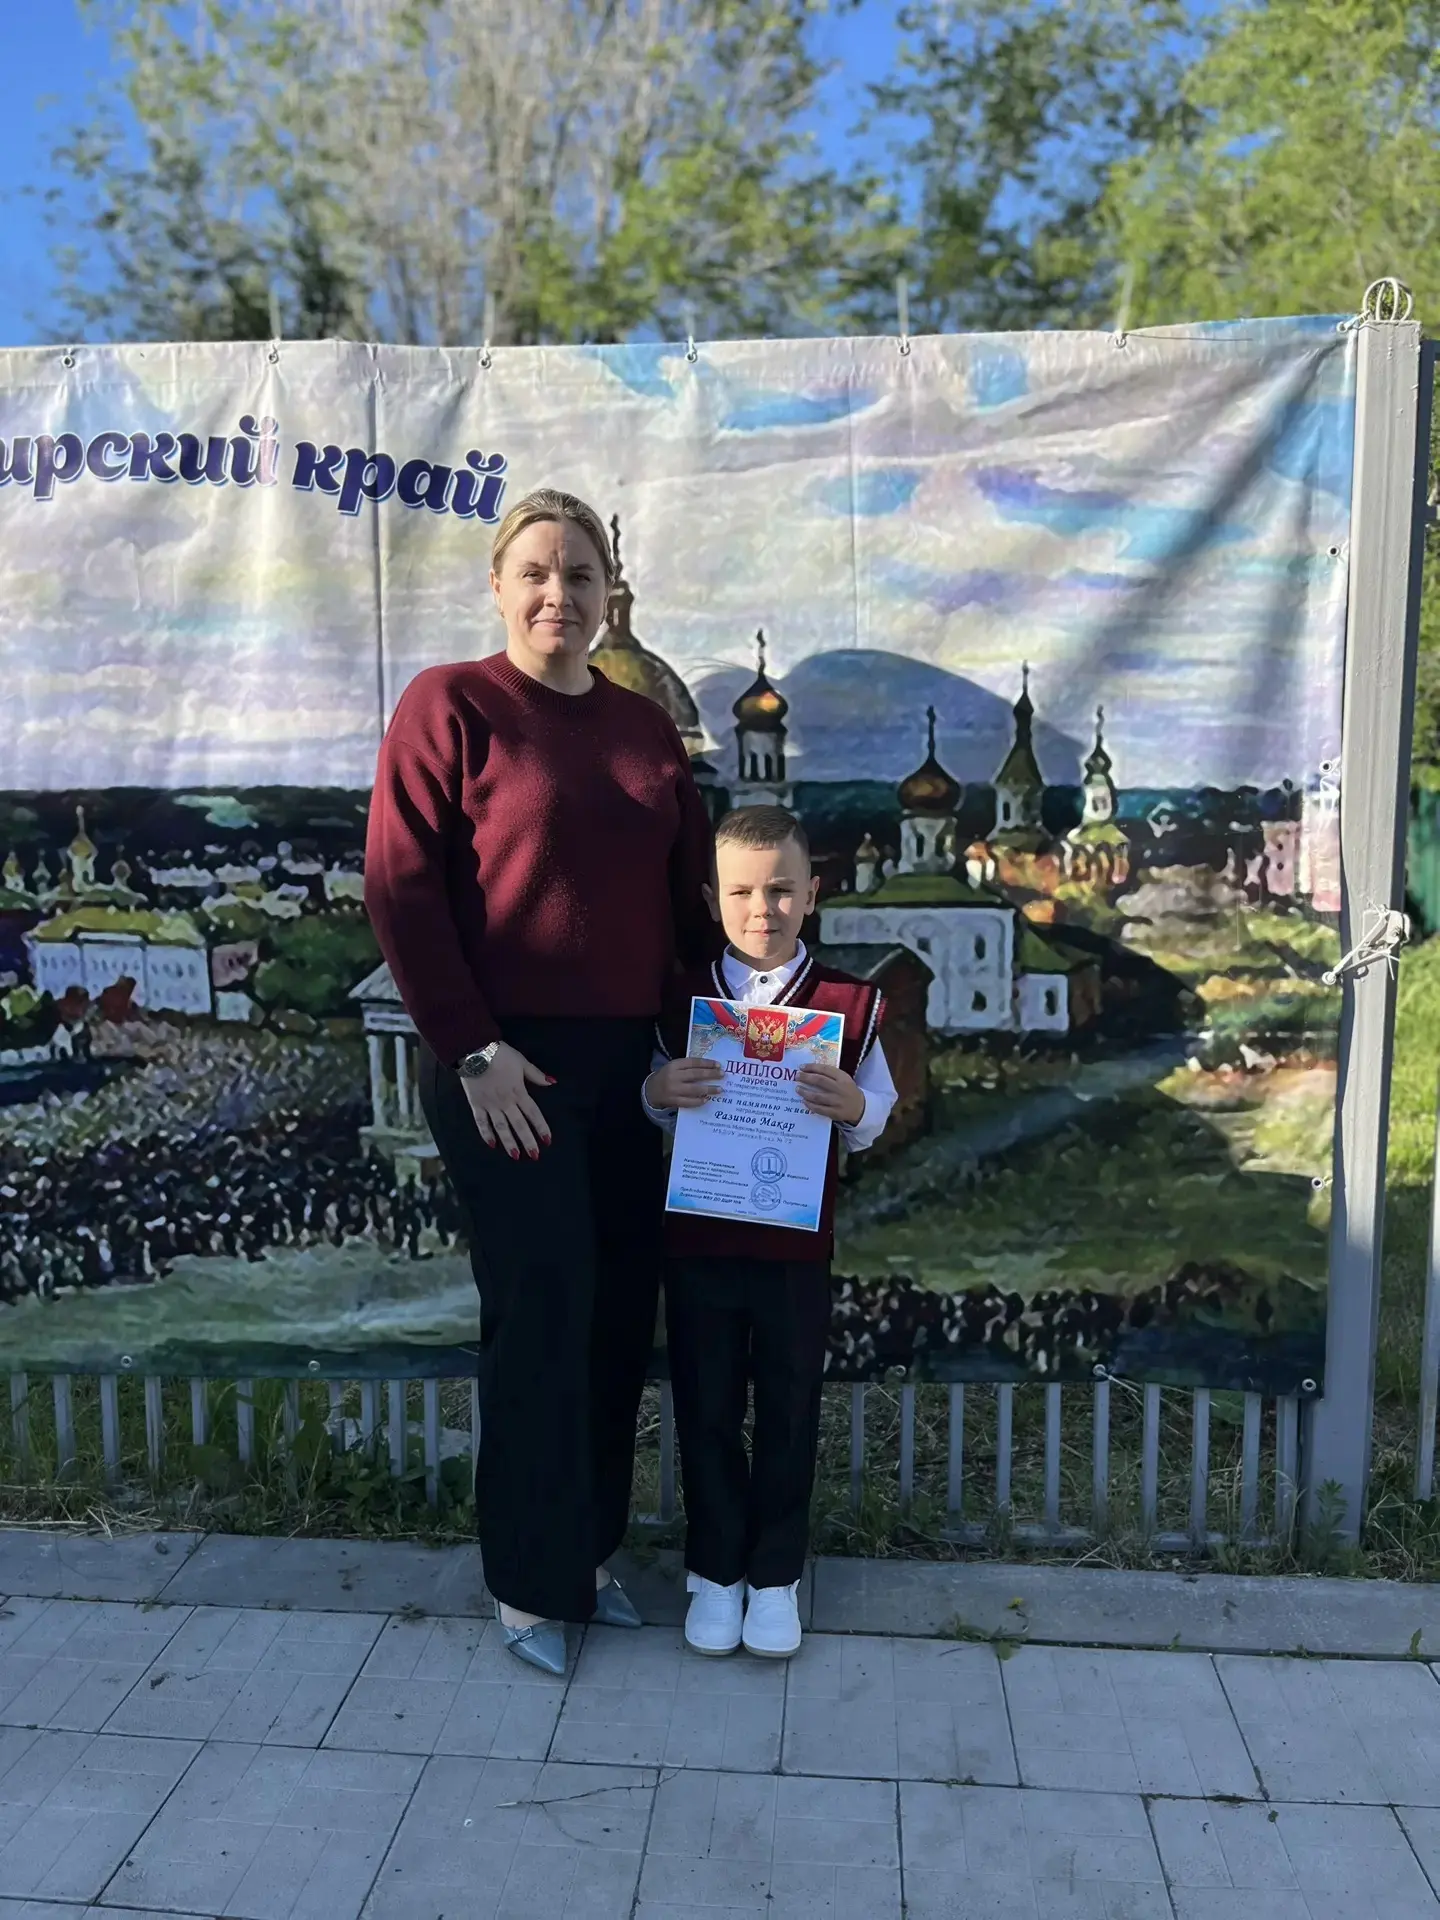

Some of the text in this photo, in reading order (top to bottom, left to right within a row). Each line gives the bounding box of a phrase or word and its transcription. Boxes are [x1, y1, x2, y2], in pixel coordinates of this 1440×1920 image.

[292, 440, 507, 523] край
[724, 1060, 798, 1081] ДИПЛОМ
[740, 1076, 778, 1088] лауреата
[704, 1095, 732, 1104] оссия
[736, 1099, 781, 1110] памятью
[714, 1110, 757, 1124] Разинов
[760, 1117, 796, 1132] Макар
